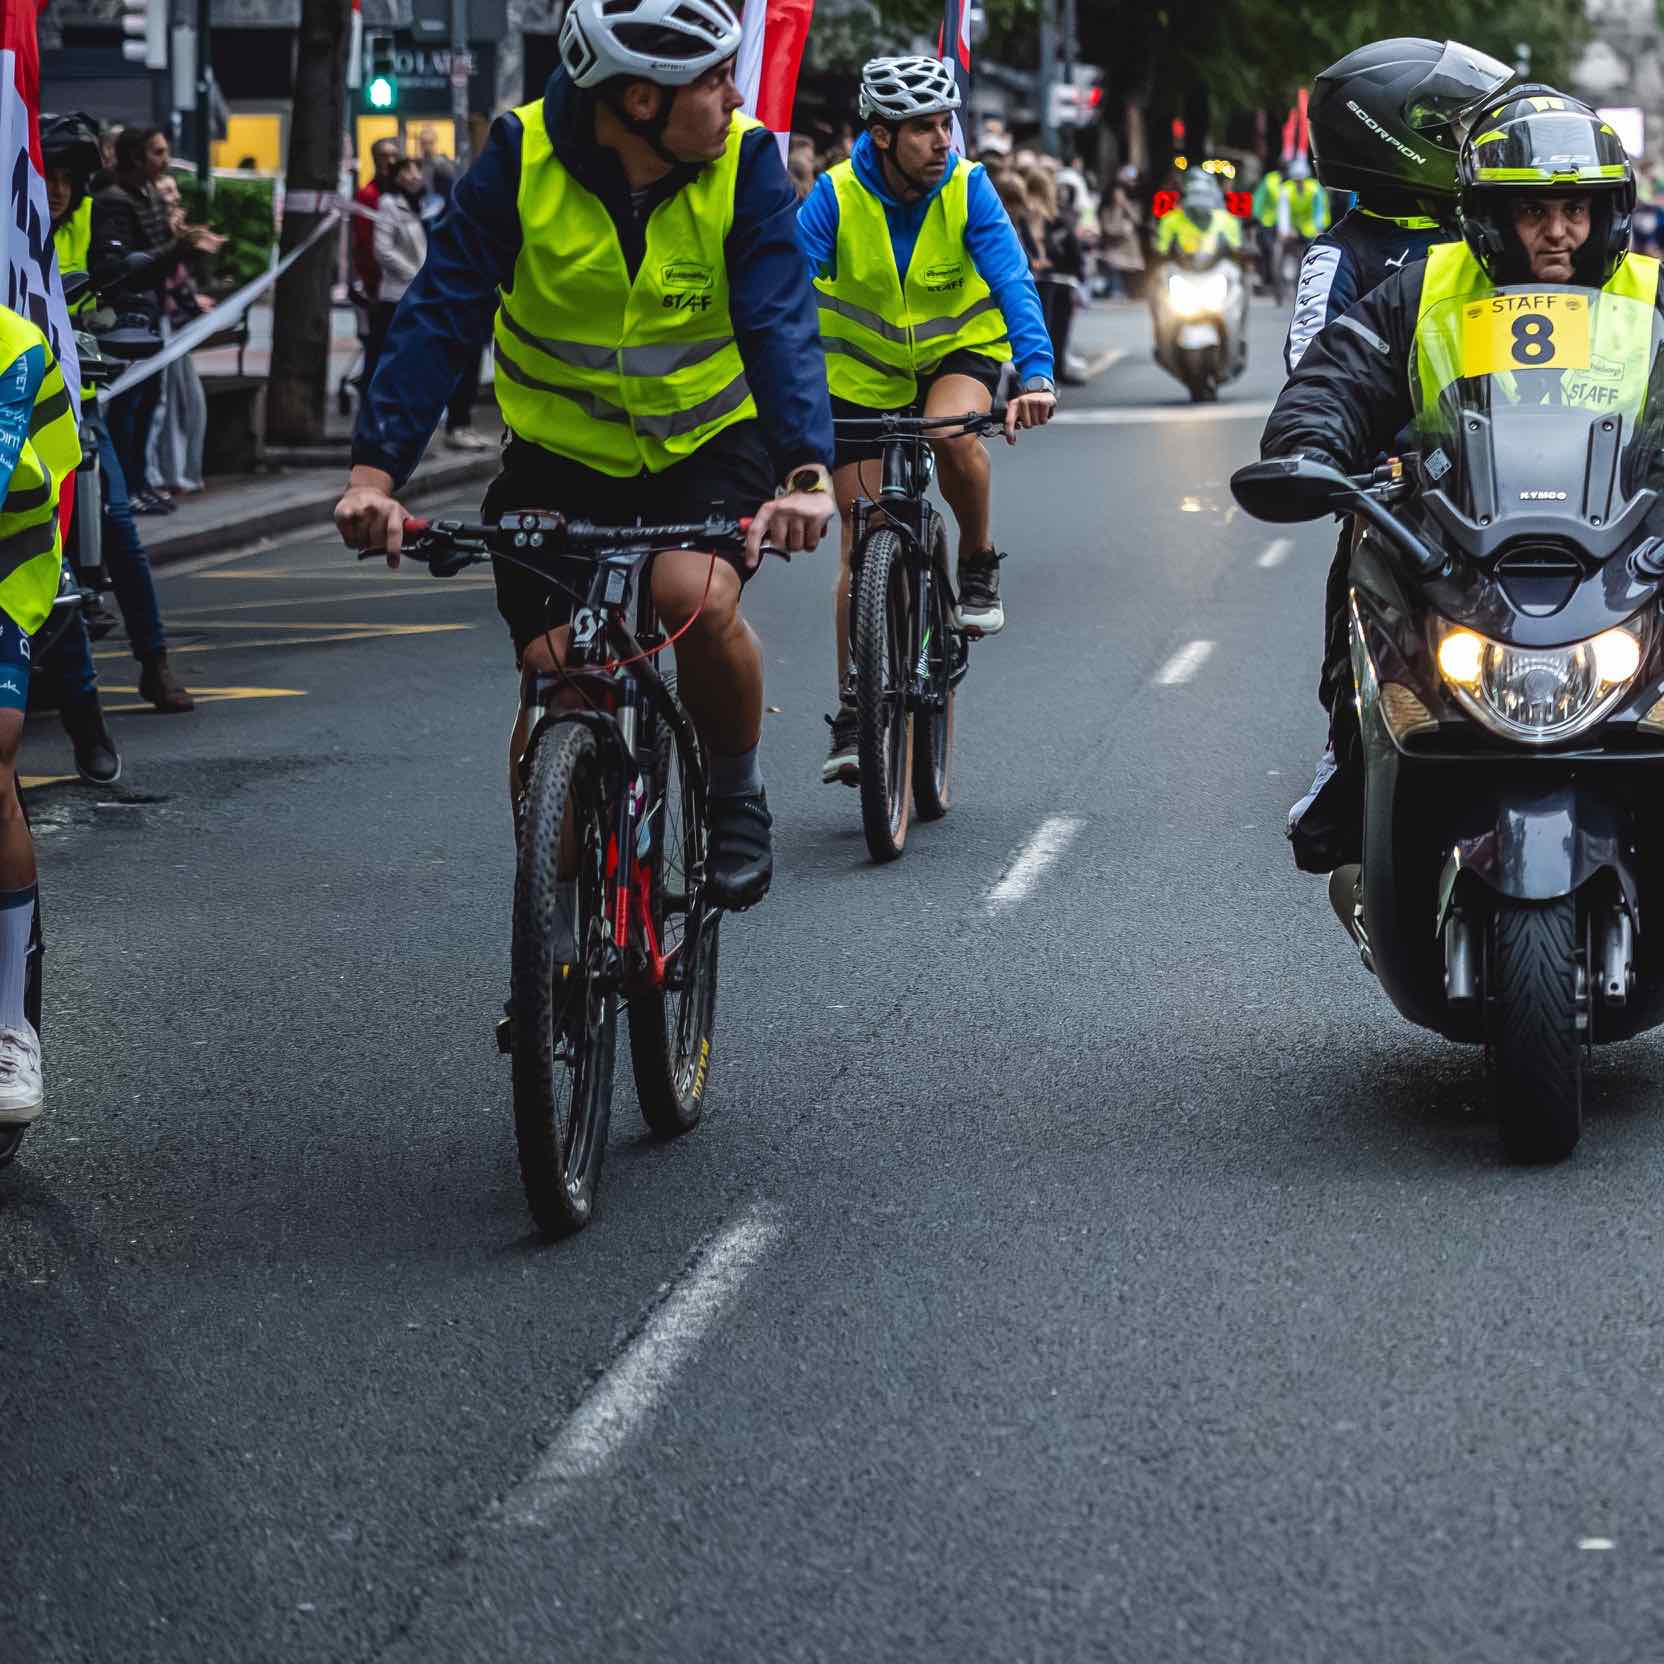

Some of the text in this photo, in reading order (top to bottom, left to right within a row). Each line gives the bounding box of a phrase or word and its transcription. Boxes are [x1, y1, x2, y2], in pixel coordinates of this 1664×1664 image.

[1346, 100, 1427, 165] SCORPION
[662, 294, 712, 312] STAFF
[1492, 296, 1559, 313] STAFF
[1511, 313, 1556, 365] 8
[1568, 383, 1619, 405] STAFF
[1519, 490, 1568, 501] KYMCO
